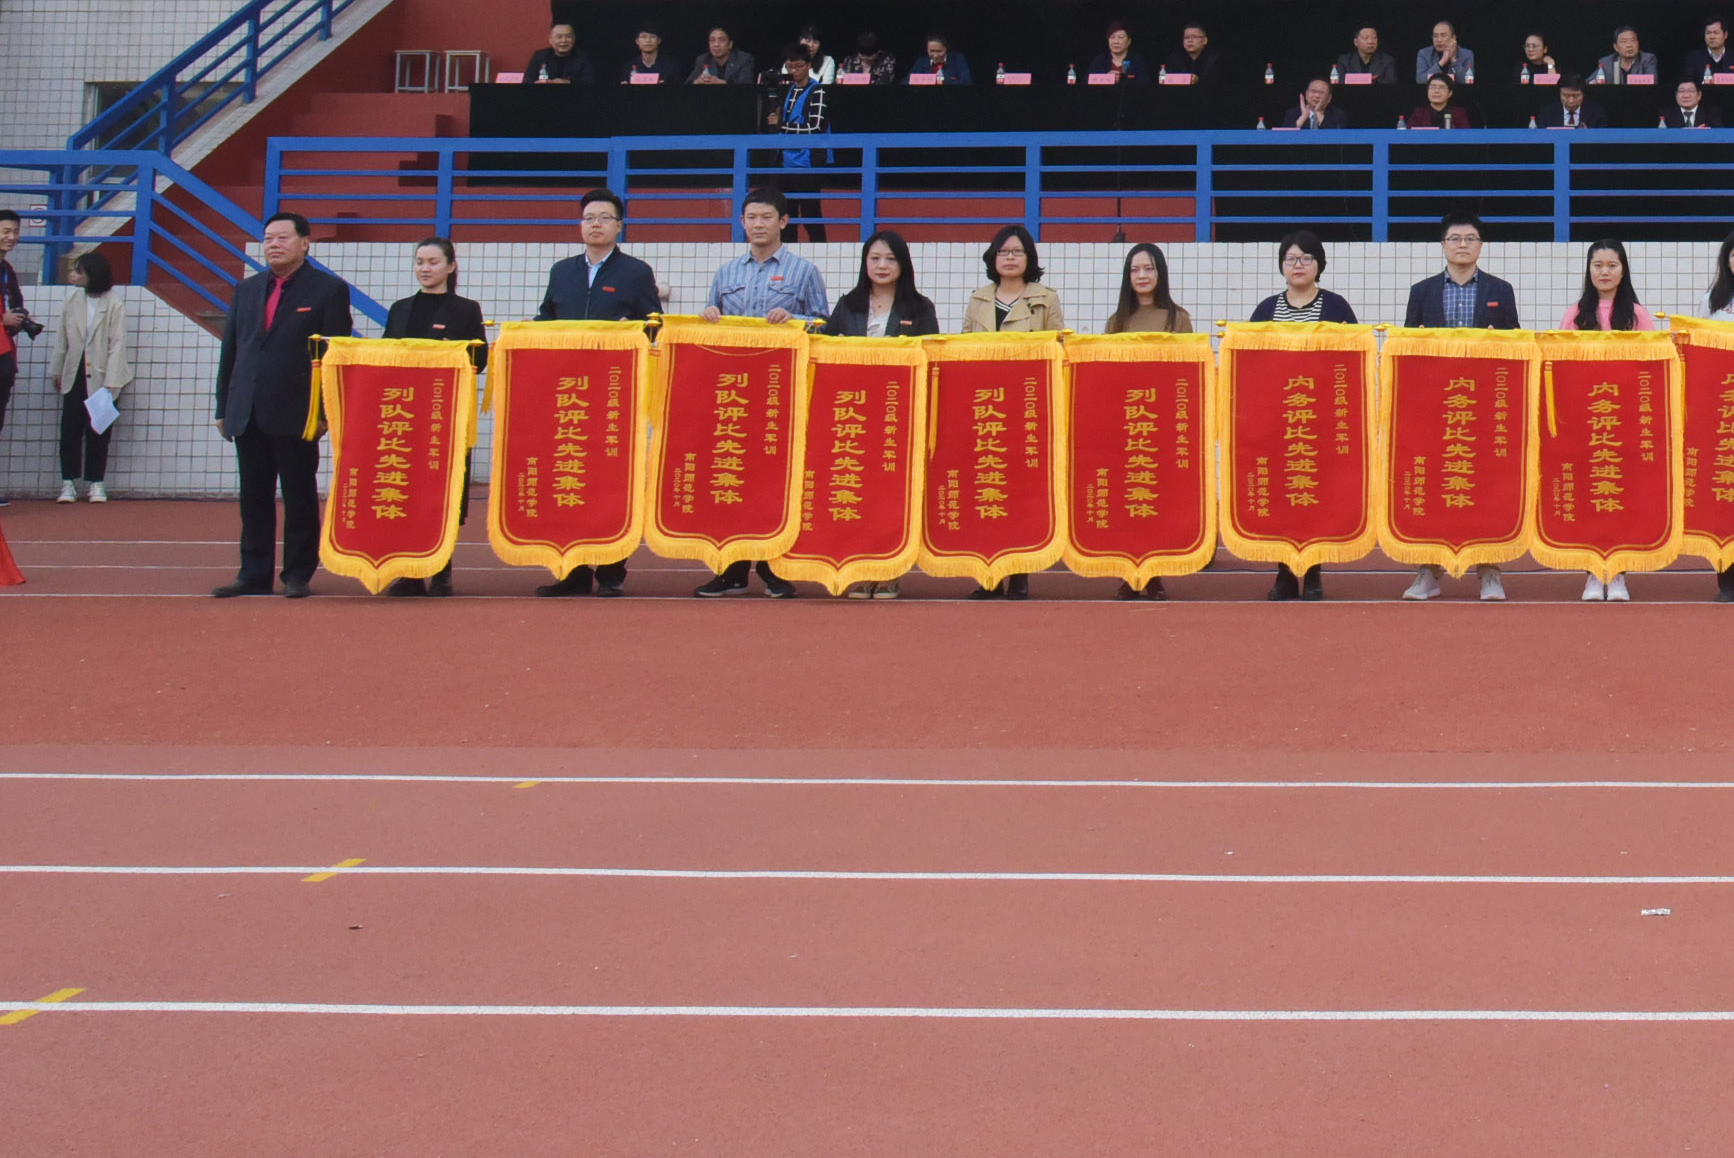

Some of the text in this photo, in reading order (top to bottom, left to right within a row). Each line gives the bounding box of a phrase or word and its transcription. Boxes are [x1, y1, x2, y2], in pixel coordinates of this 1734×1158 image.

[372, 387, 414, 520] 列队评比先进集体
[552, 376, 589, 506] 列队评比先进集体
[711, 373, 749, 504] 列队评比先进集体
[829, 390, 867, 521] 列队评比先进集体
[973, 387, 1008, 519] 列队评比先进集体
[1124, 388, 1158, 518] 列队评比先进集体
[1283, 375, 1319, 506] 内务评比先进集体
[1442, 378, 1477, 508] 内务评比先进集体
[1588, 382, 1624, 512] 内务评比先进集体
